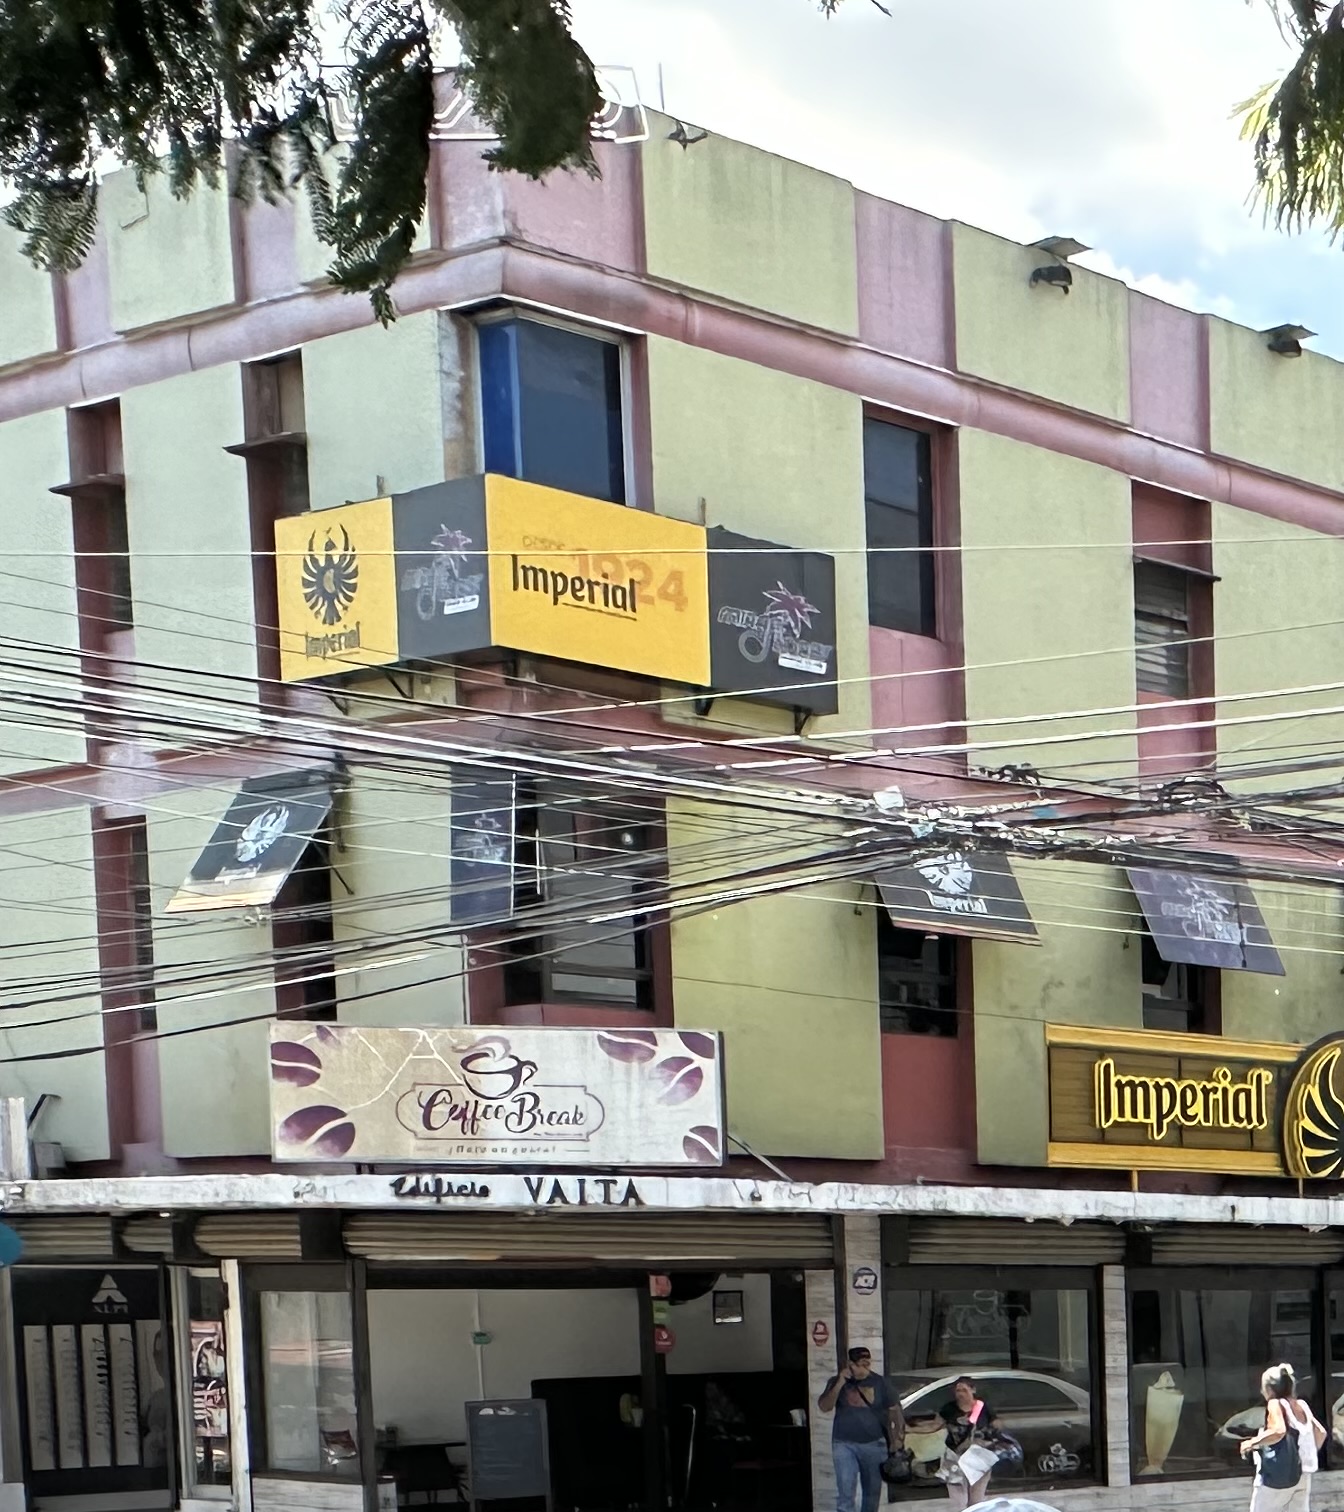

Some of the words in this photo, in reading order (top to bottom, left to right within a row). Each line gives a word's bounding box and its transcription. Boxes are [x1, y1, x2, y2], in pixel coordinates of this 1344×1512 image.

[511, 553, 637, 613] Imperial
[504, 1091, 585, 1133] Break
[1095, 1058, 1268, 1140] Imperial
